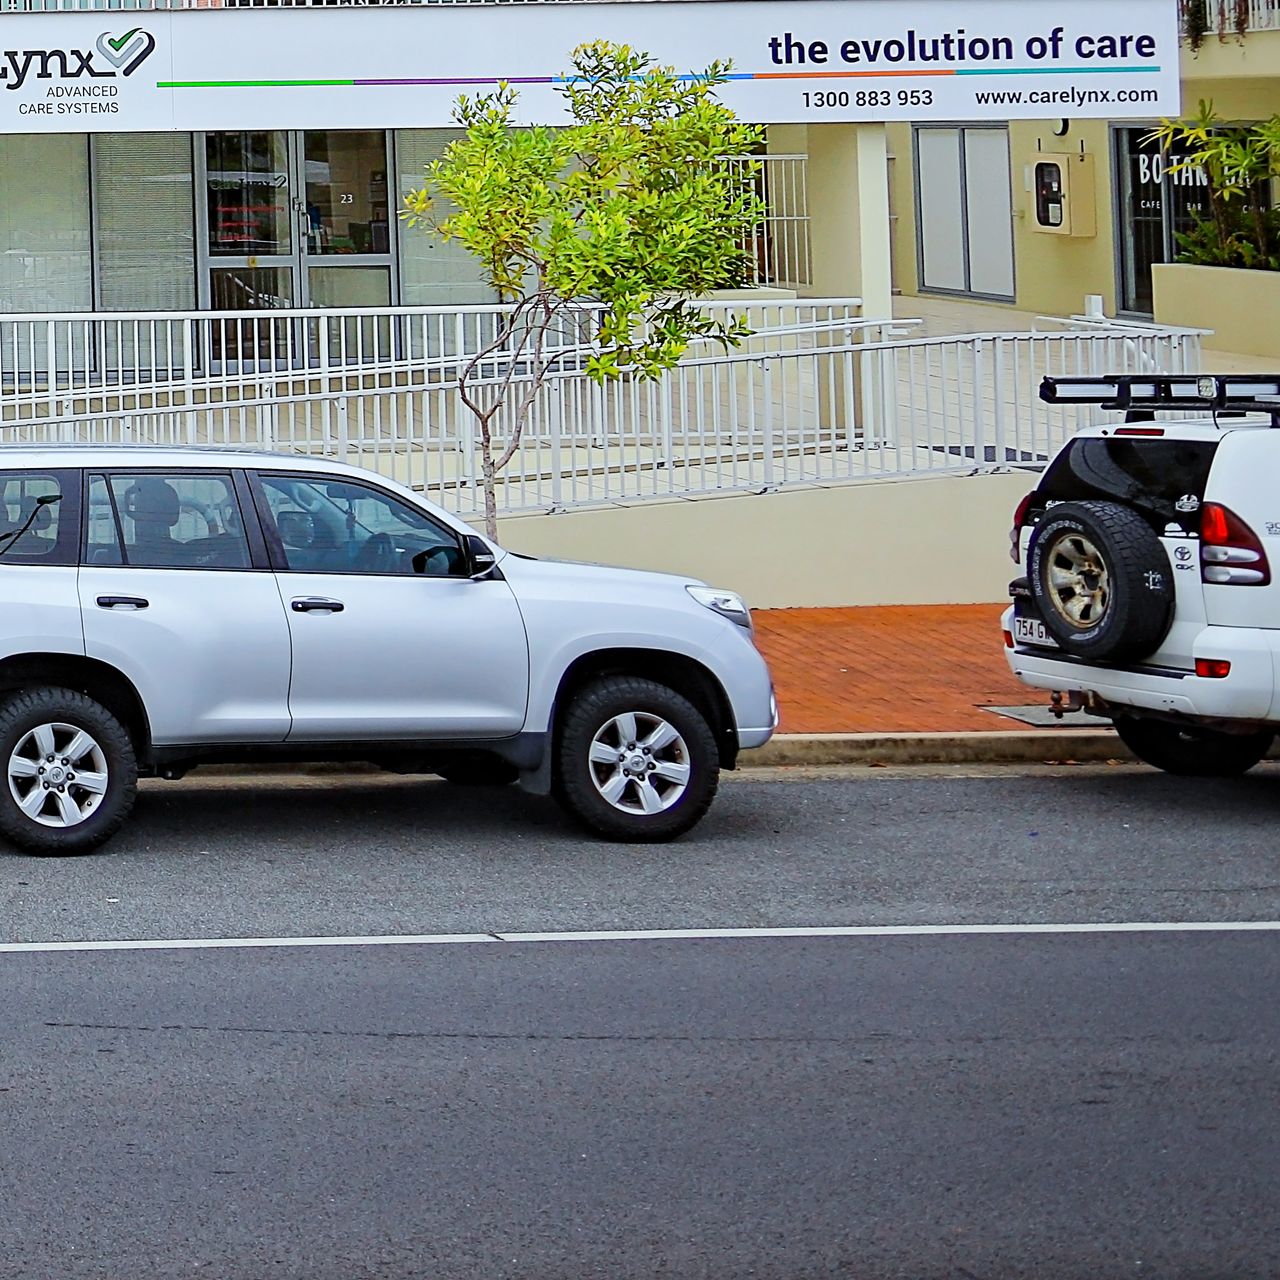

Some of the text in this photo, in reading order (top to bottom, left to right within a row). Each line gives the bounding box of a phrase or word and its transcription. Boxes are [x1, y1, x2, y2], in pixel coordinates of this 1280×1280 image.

[767, 27, 1156, 65] the evolution of care
[46, 85, 119, 98] ADVANCED
[801, 89, 934, 109] 1300 883 953
[975, 86, 1158, 108] www.carelynx.com
[18, 101, 120, 115] CARE SYSTEMS
[340, 194, 353, 204] 23
[1140, 200, 1160, 209] CAFE
[1016, 619, 1034, 638] 754
